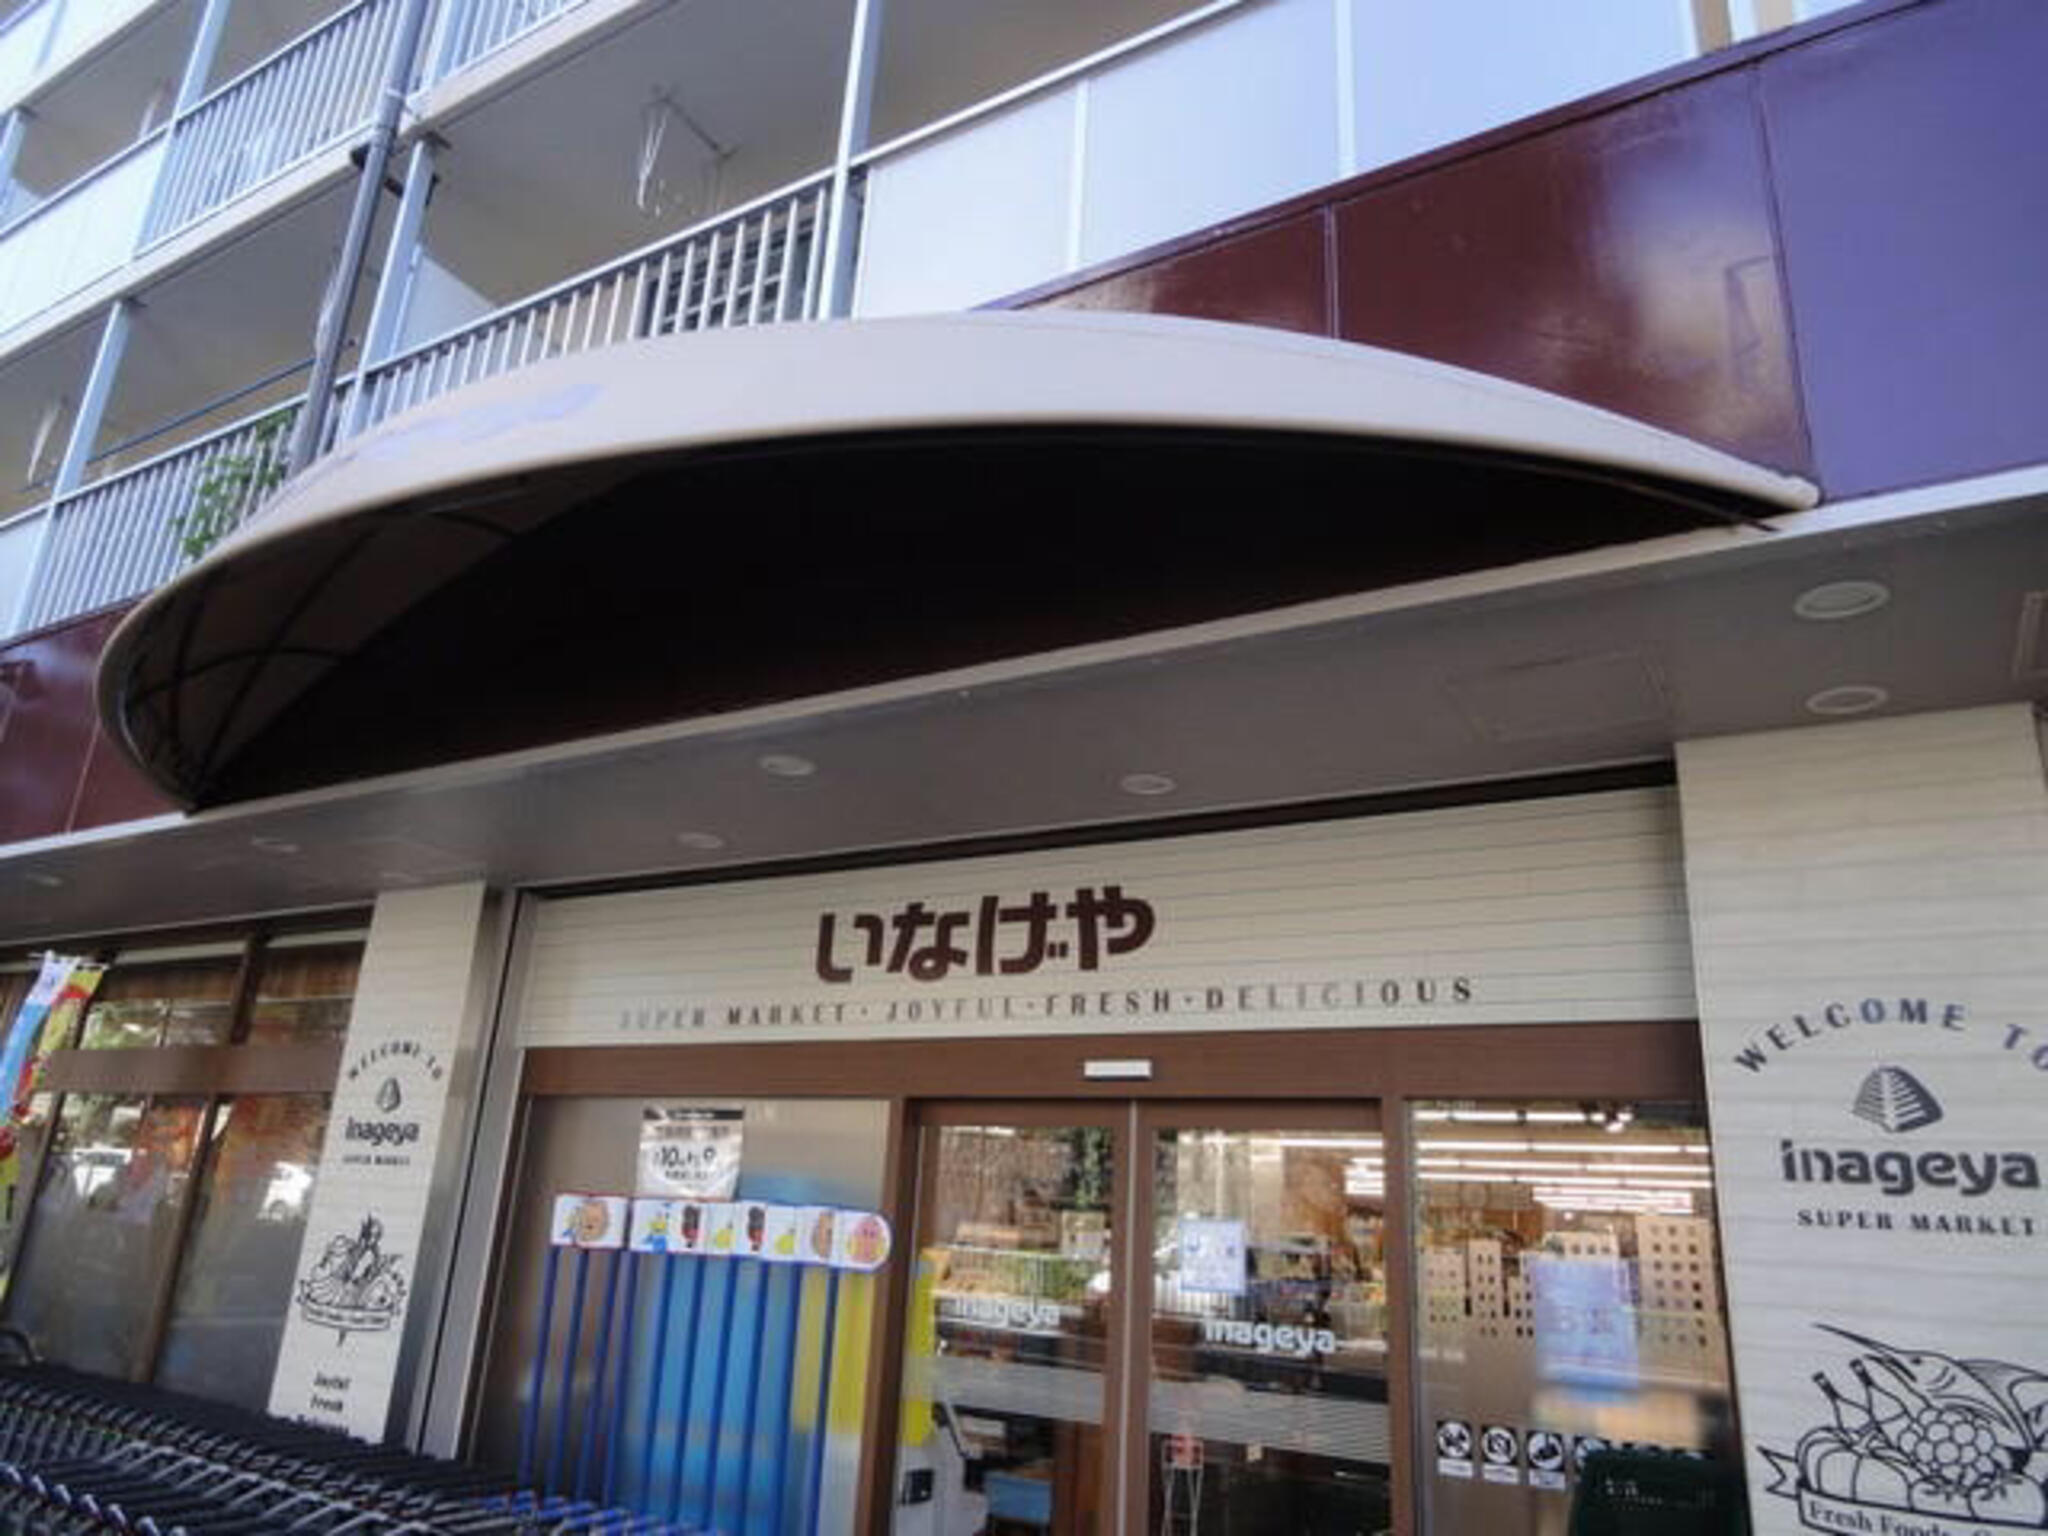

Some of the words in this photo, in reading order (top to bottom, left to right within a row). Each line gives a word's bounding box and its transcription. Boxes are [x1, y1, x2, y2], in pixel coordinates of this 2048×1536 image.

[816, 885, 1156, 983] いなげや
[620, 1006, 705, 1031] SUPER
[728, 1003, 845, 1025] MARKET
[886, 999, 1013, 1022] JOYFUL
[1045, 990, 1170, 1016] FRESH
[1206, 977, 1473, 1011] DELICIOUS
[1733, 997, 1967, 1073] WELCOME
[345, 1116, 420, 1147] inageya
[1781, 1139, 2041, 1197] inageya
[1797, 1209, 1893, 1231] SUPER
[1911, 1214, 2036, 1237] MARKET
[1808, 1501, 1873, 1533] Fresh
